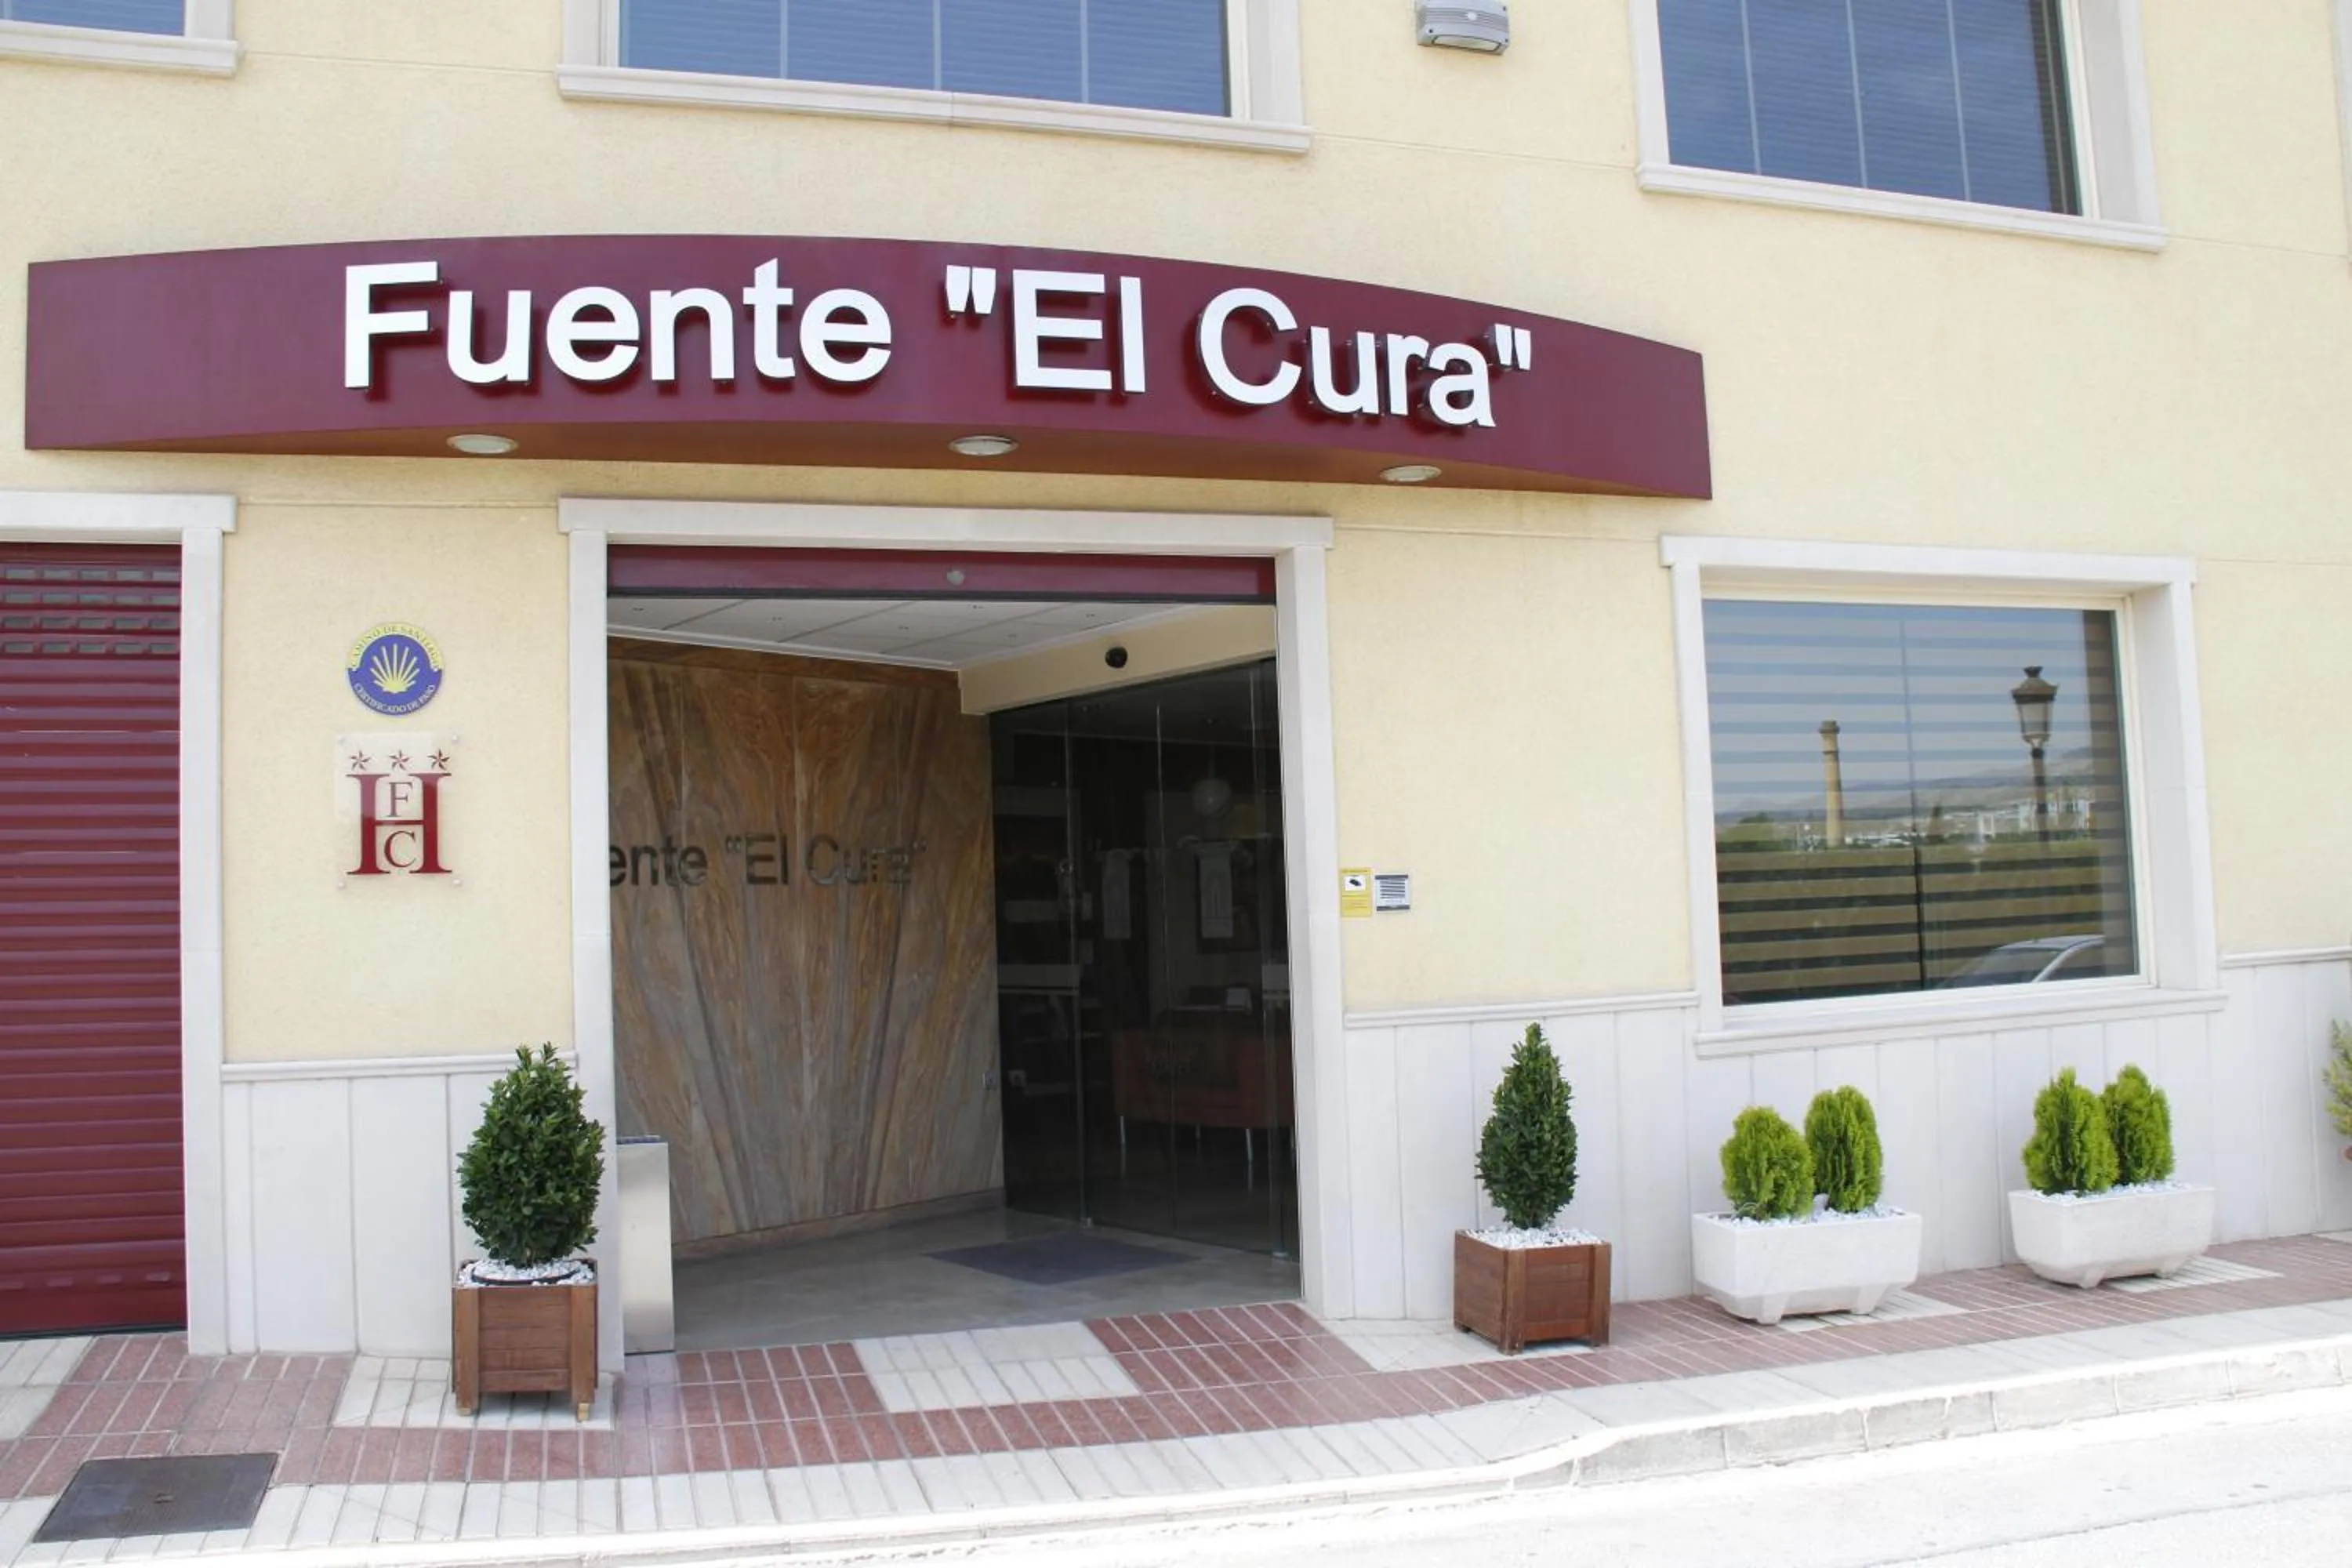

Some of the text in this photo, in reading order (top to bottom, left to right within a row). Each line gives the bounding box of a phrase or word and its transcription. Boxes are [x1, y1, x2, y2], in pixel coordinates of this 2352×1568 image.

[345, 258, 1531, 427] Fuente "El Cura"
[725, 834, 789, 886] "El
